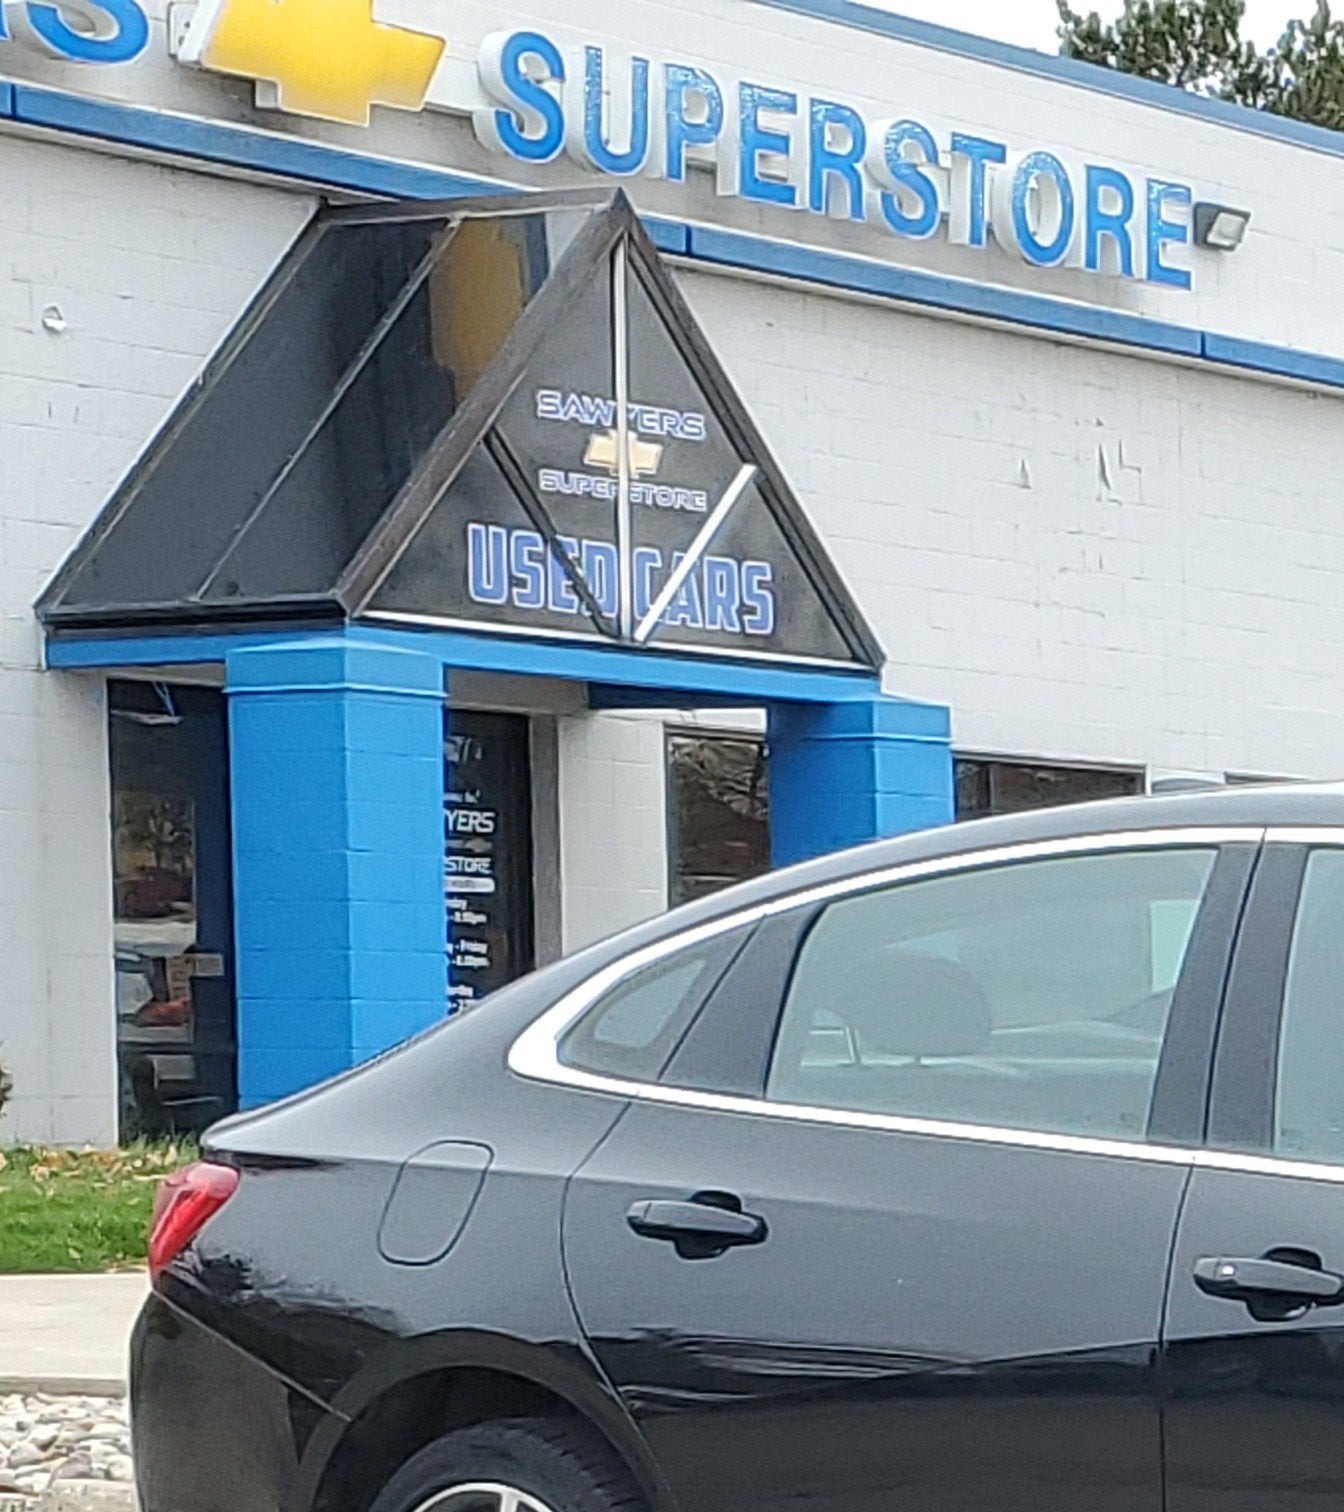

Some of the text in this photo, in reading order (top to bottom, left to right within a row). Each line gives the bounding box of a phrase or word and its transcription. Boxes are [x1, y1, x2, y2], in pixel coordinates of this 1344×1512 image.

[488, 28, 1194, 292] SUPERSTORE
[466, 522, 775, 636] USED CARS
